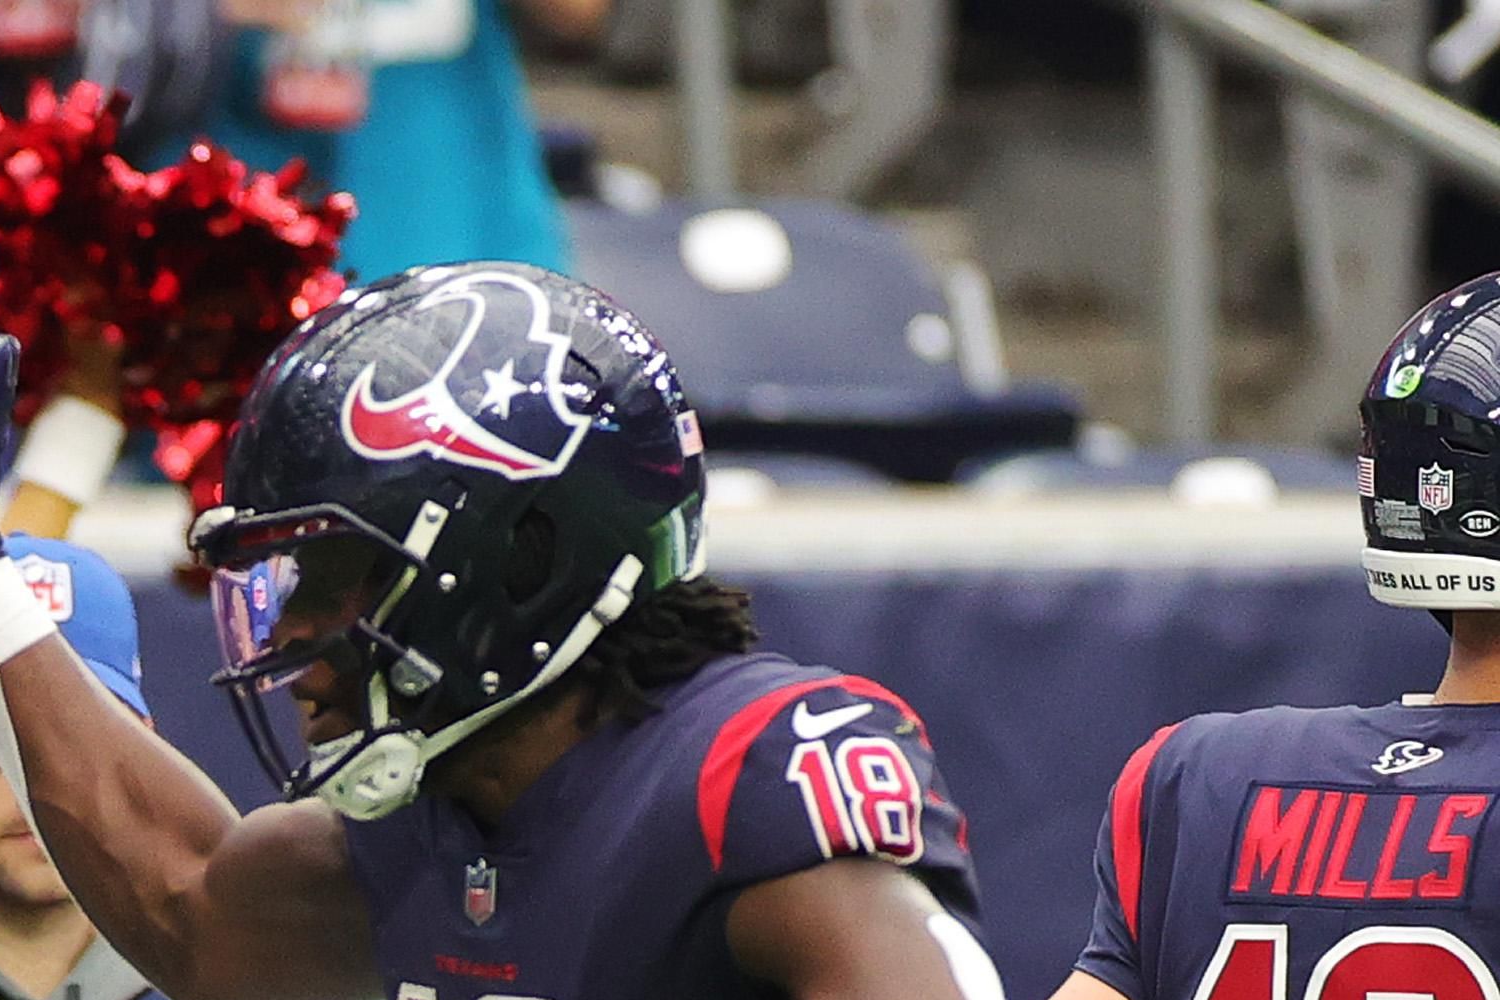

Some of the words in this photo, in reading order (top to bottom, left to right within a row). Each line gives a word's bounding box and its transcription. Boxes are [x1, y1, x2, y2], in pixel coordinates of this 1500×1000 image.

[1423, 486, 1449, 507] NFL
[1401, 574, 1432, 590] ALL
[1436, 575, 1461, 591] OF
[1467, 576, 1496, 591] US
[786, 736, 924, 866] 18
[1231, 786, 1489, 900] MILLS
